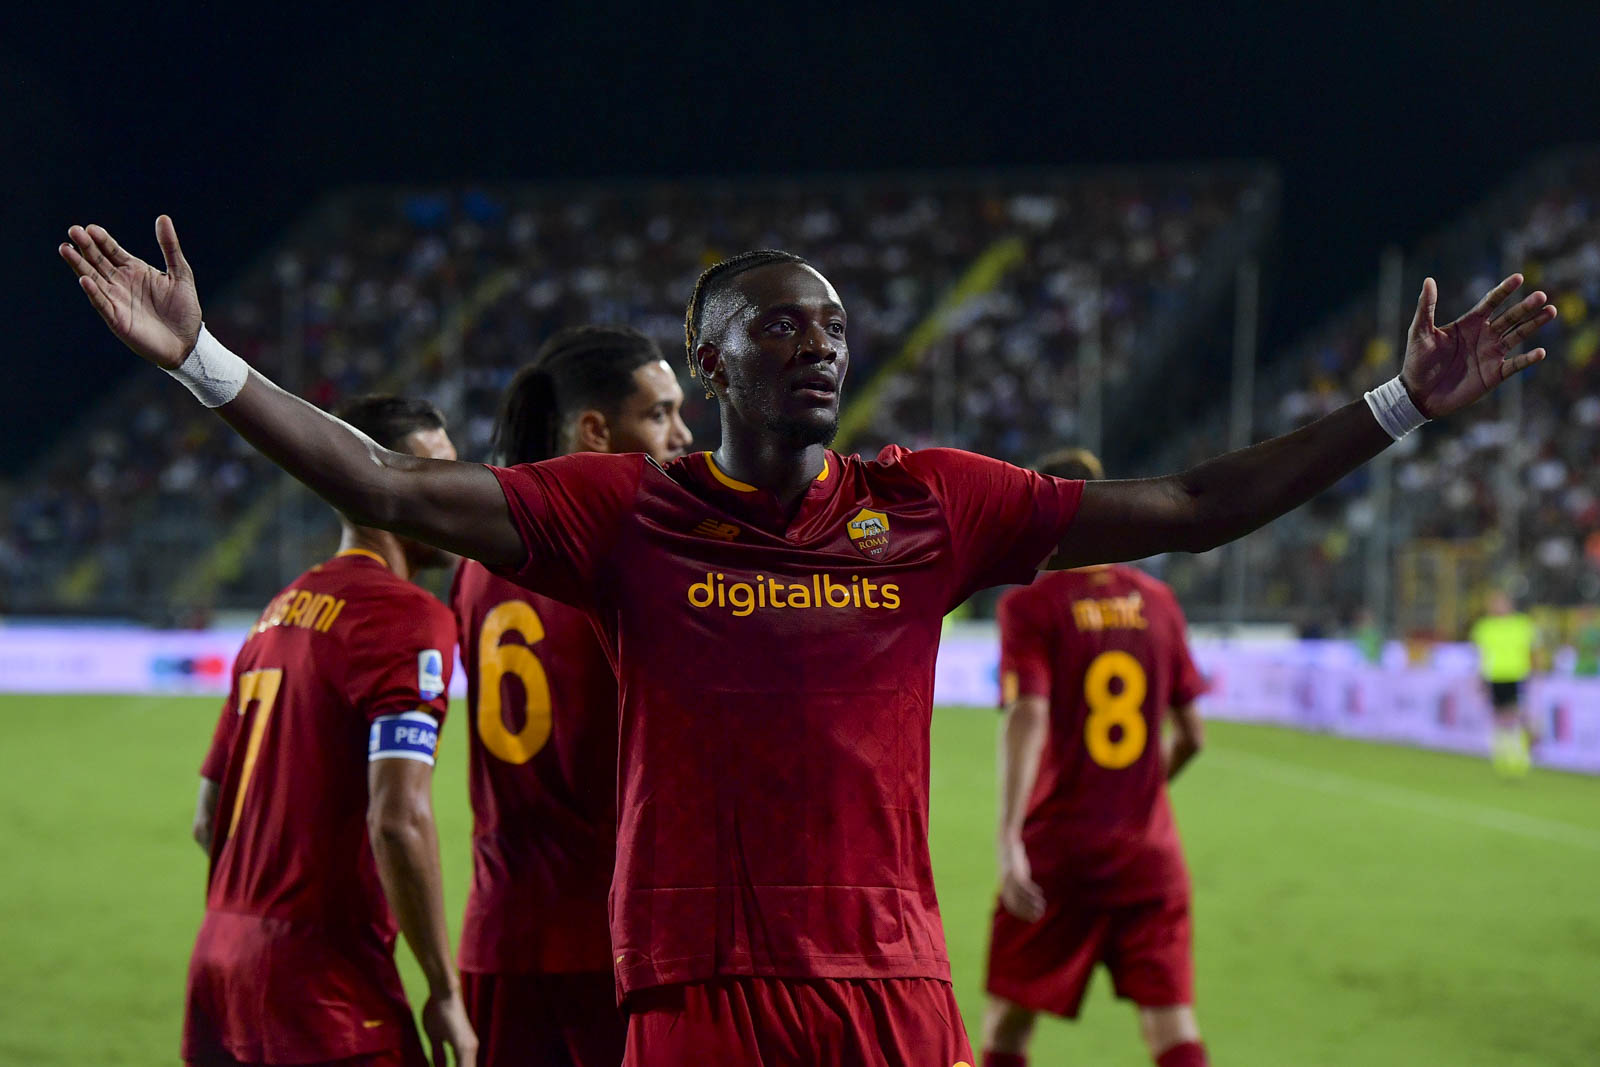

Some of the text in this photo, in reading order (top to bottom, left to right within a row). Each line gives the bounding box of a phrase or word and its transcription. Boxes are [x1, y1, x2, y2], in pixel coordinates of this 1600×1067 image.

[687, 572, 901, 617] digitalbits
[858, 536, 888, 550] ROMA
[477, 599, 552, 765] 6
[1083, 650, 1148, 770] 8
[227, 667, 283, 841] 7
